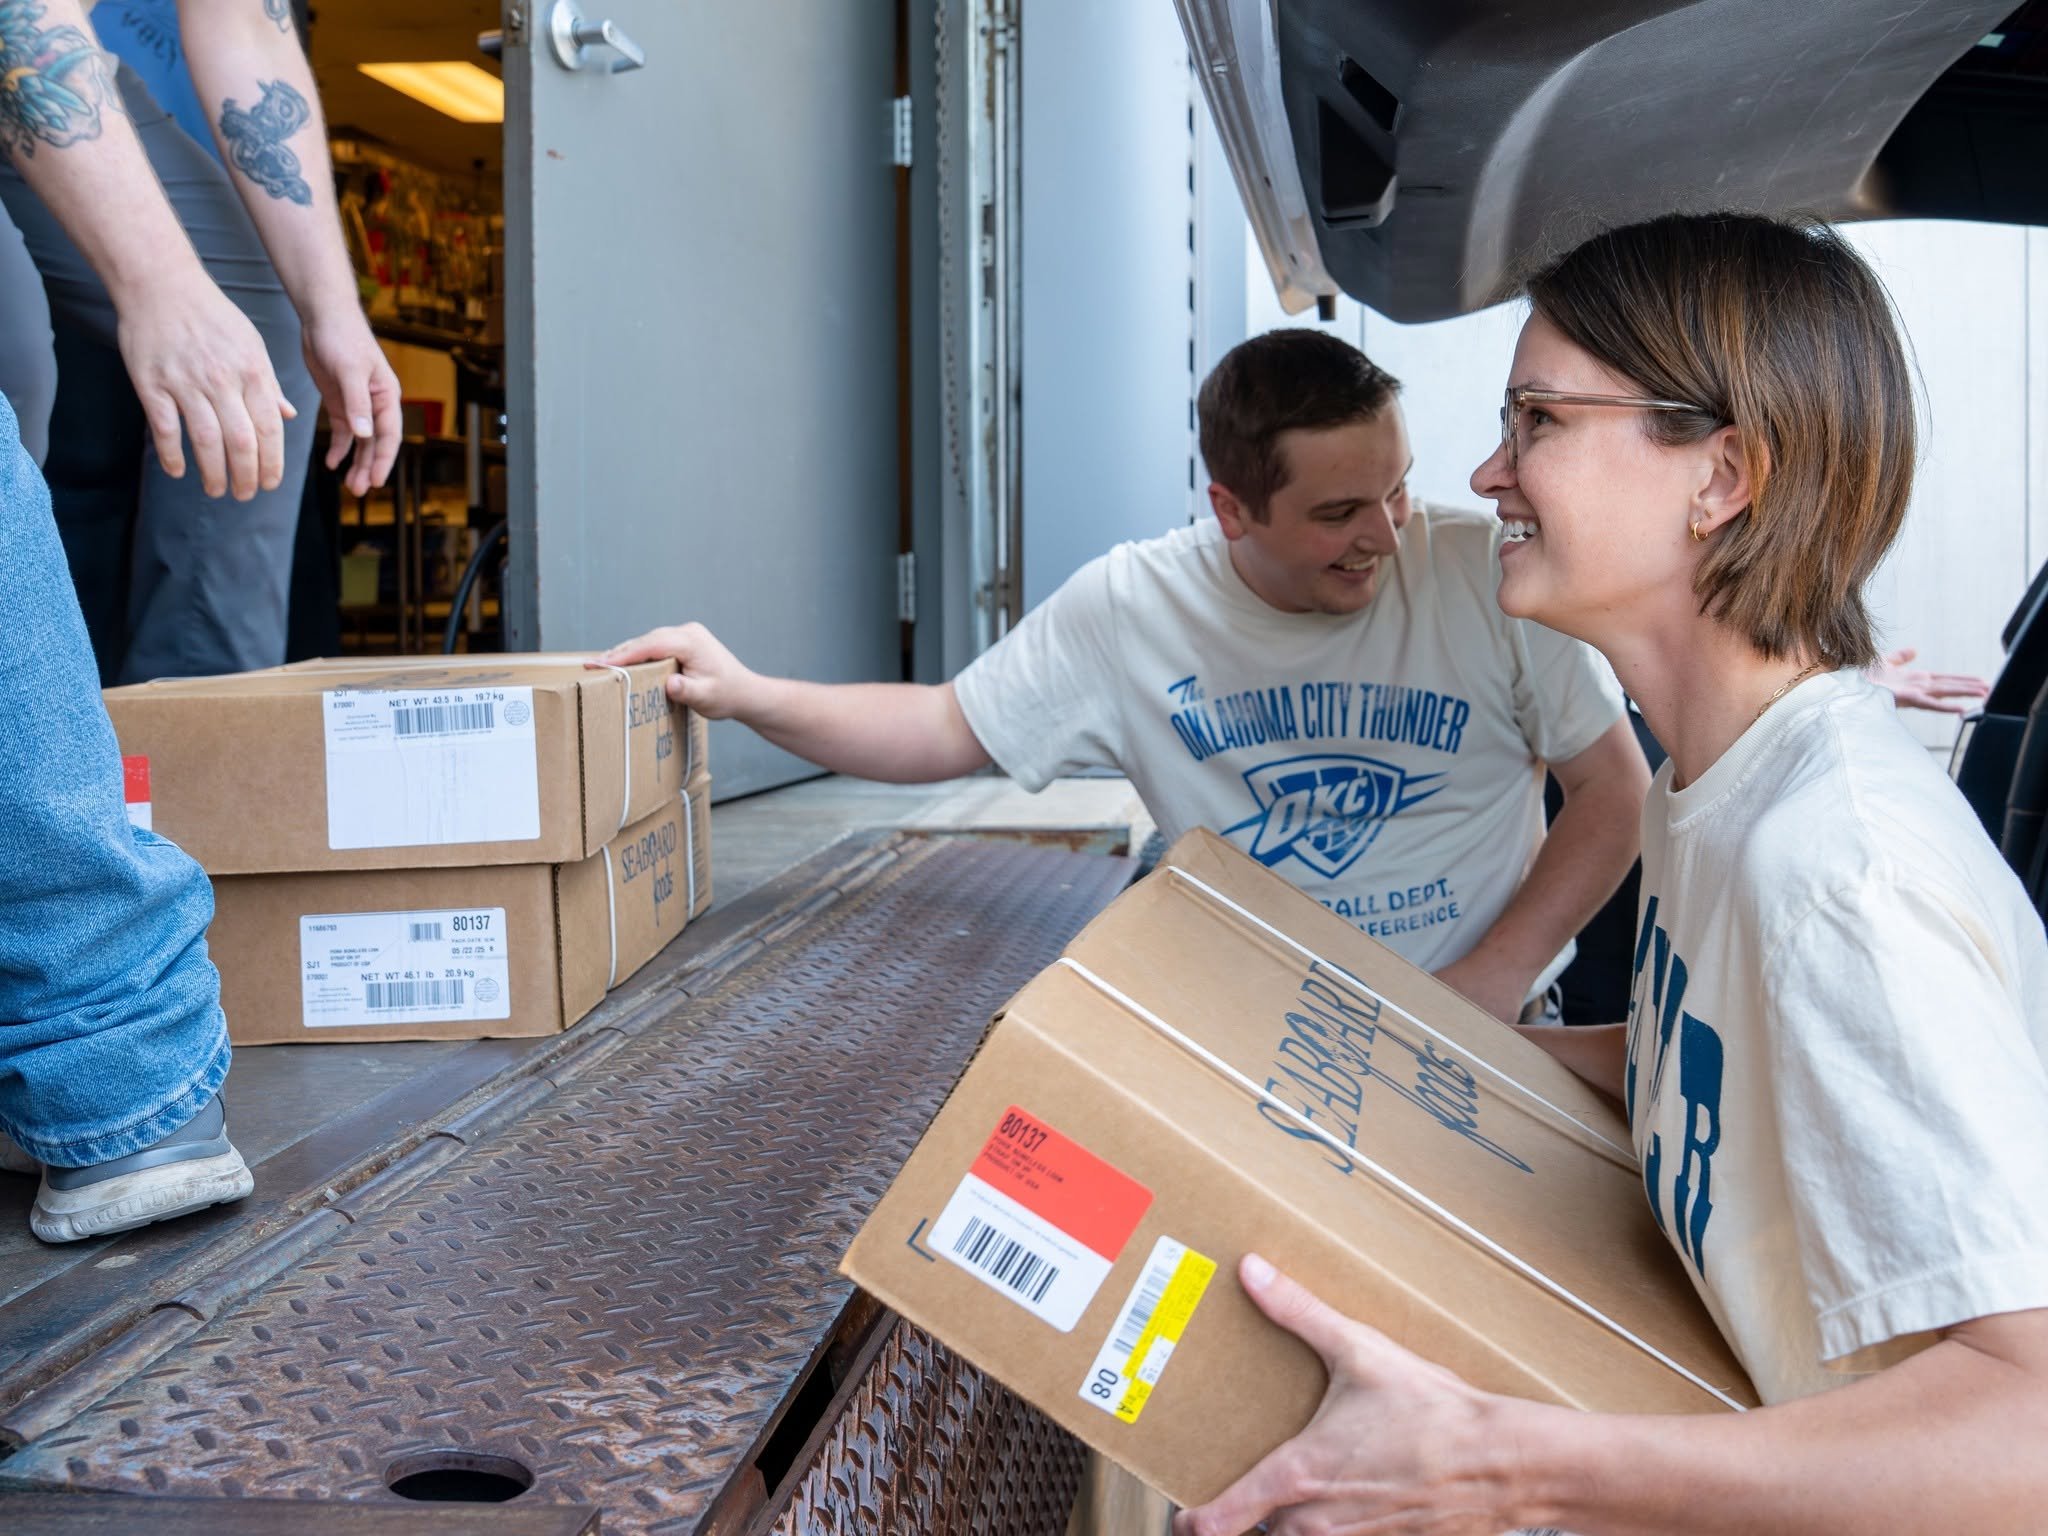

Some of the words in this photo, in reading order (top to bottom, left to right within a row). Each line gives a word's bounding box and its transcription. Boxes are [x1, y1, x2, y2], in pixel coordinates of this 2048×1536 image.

[389, 699, 408, 708] NET
[413, 697, 429, 706] WT
[432, 696, 450, 705] 43.5
[454, 694, 464, 703] lb
[475, 692, 492, 701] 19.7
[493, 691, 505, 701] kg
[1167, 675, 1205, 705] The
[1170, 684, 1299, 762] OKLAHOMA
[1301, 681, 1353, 741] CITY
[1359, 681, 1471, 755] THUNDER
[1254, 773, 1369, 856] OKC
[621, 821, 677, 883] SEABOARD
[1388, 878, 1454, 911] DEPT.
[452, 915, 491, 932] 80137
[1360, 901, 1460, 936] FERENCE
[306, 961, 320, 969] SJ1
[361, 973, 380, 981] NET
[385, 972, 400, 980] WT
[404, 971, 420, 979] 46.1
[445, 969, 462, 977] 20.9
[464, 969, 475, 978] kg
[1257, 959, 1382, 1176] SEABOARD
[1000, 1112, 1048, 1153] 80137
